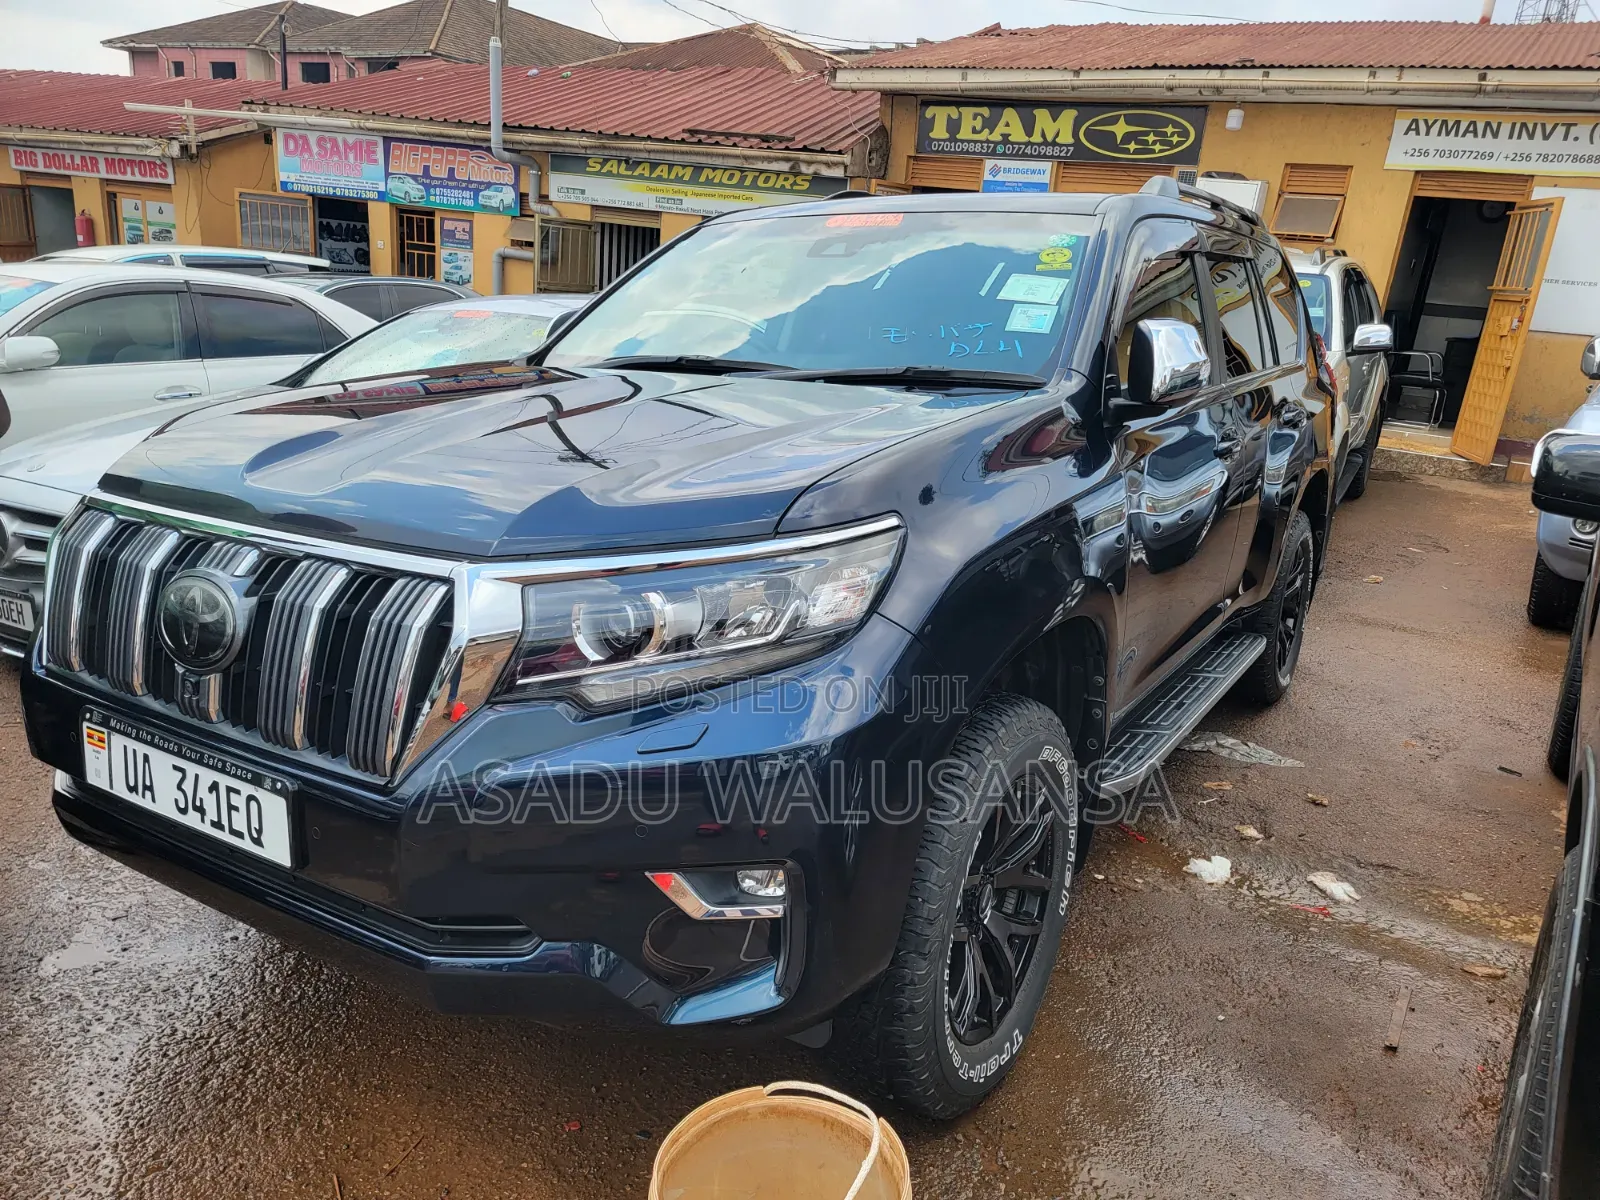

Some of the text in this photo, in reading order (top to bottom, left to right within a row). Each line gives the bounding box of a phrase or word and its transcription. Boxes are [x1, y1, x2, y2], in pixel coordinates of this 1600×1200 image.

[925, 105, 1079, 144] TEAM
[1403, 118, 1502, 140] AYMAN
[1508, 121, 1580, 142] INVT.
[283, 132, 379, 165] DA SAMIE
[931, 141, 1074, 157] 0701098837 0774098827
[1403, 148, 1430, 158] +256
[1432, 148, 1494, 161] 703077269
[1503, 153, 1532, 163] +256
[13, 149, 169, 179] BIG DOLLAR MOTORS
[301, 157, 363, 177] MOTORS
[470, 165, 514, 185] Motors
[586, 157, 812, 190] SALAAM MOTORS
[1002, 167, 1046, 176] BRIDGEWAY
[646, 185, 664, 194] Dealers
[1561, 279, 1598, 287] SERVICES
[110, 718, 137, 737] Making
[140, 730, 152, 742] the
[154, 735, 178, 752] Roads
[181, 746, 200, 760] Your
[203, 754, 222, 769] Safe
[225, 763, 252, 780] Space
[123, 744, 265, 849] UA 341EQ
